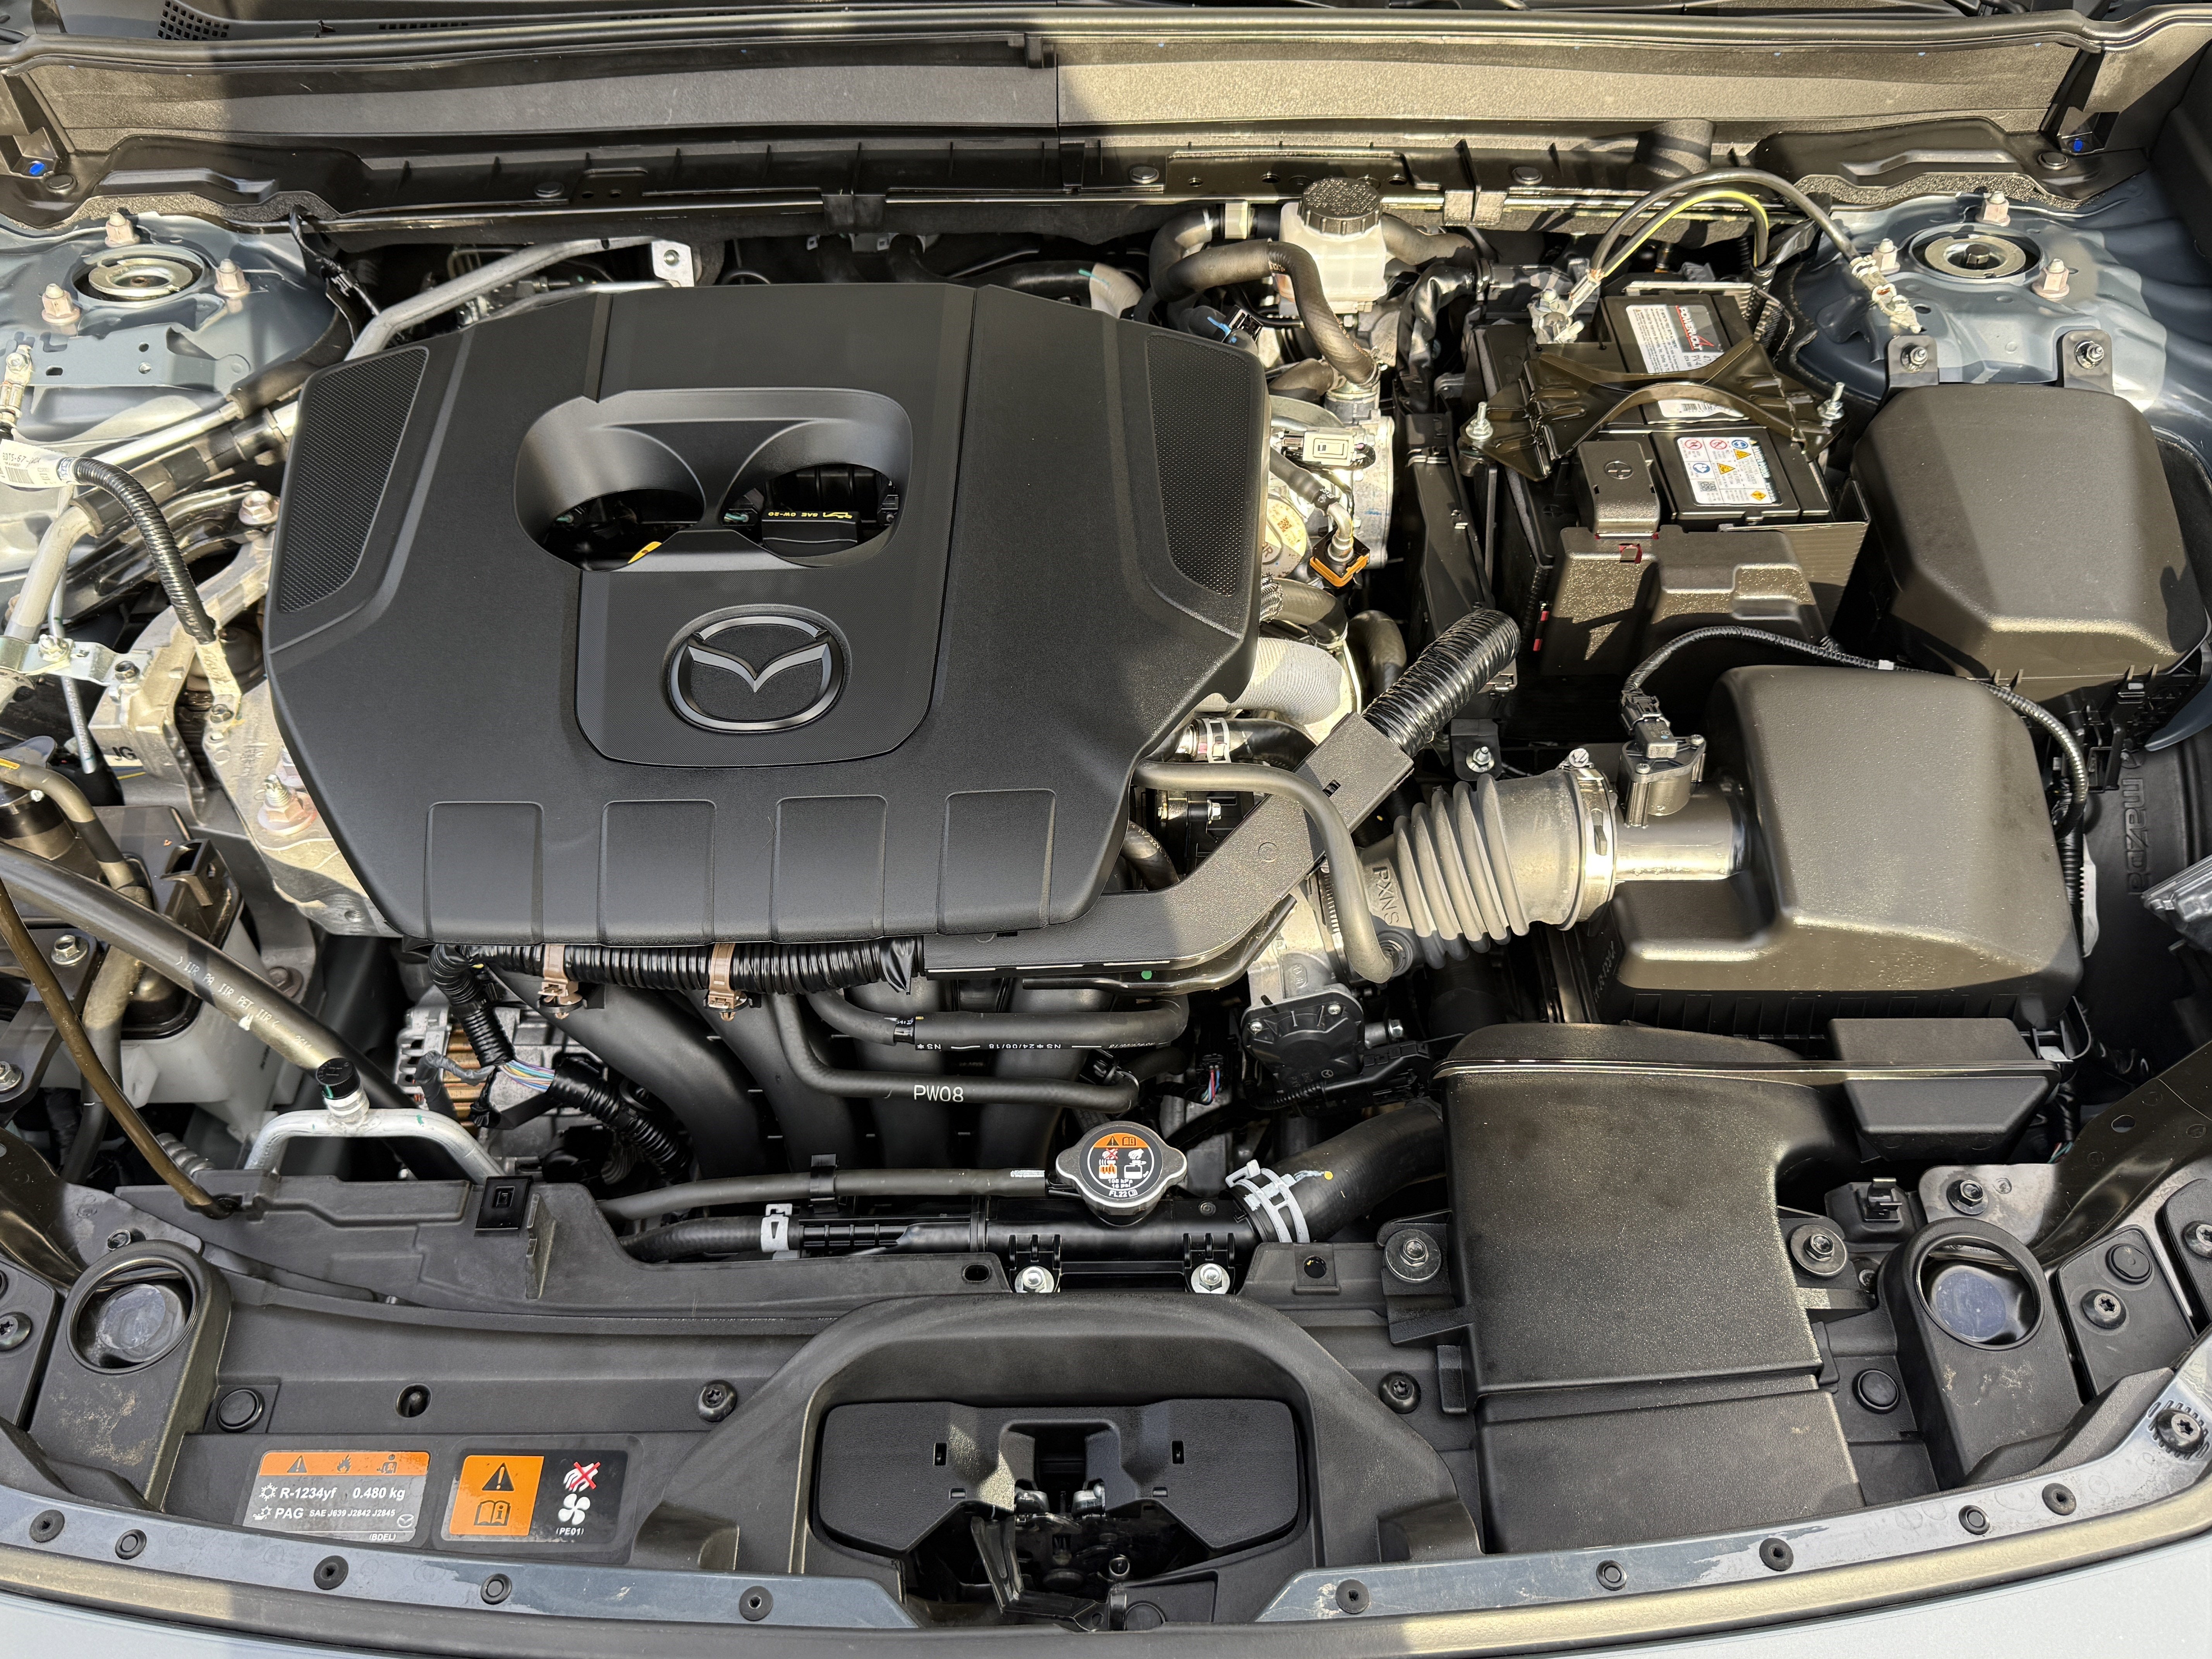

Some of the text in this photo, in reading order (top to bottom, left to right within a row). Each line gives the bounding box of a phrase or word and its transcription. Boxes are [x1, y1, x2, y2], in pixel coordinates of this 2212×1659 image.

[1679, 307, 1703, 350] POWERVOLT
[2122, 778, 2150, 895] mazda
[1372, 866, 1399, 924] PXNS
[218, 983, 234, 998] IIR
[236, 995, 255, 1010] PET
[914, 1085, 964, 1103] PW08
[280, 1487, 405, 1501] R-1234yf 0.480 kg
[275, 1508, 304, 1519] PAG
[556, 1527, 584, 1535] (PE01)
